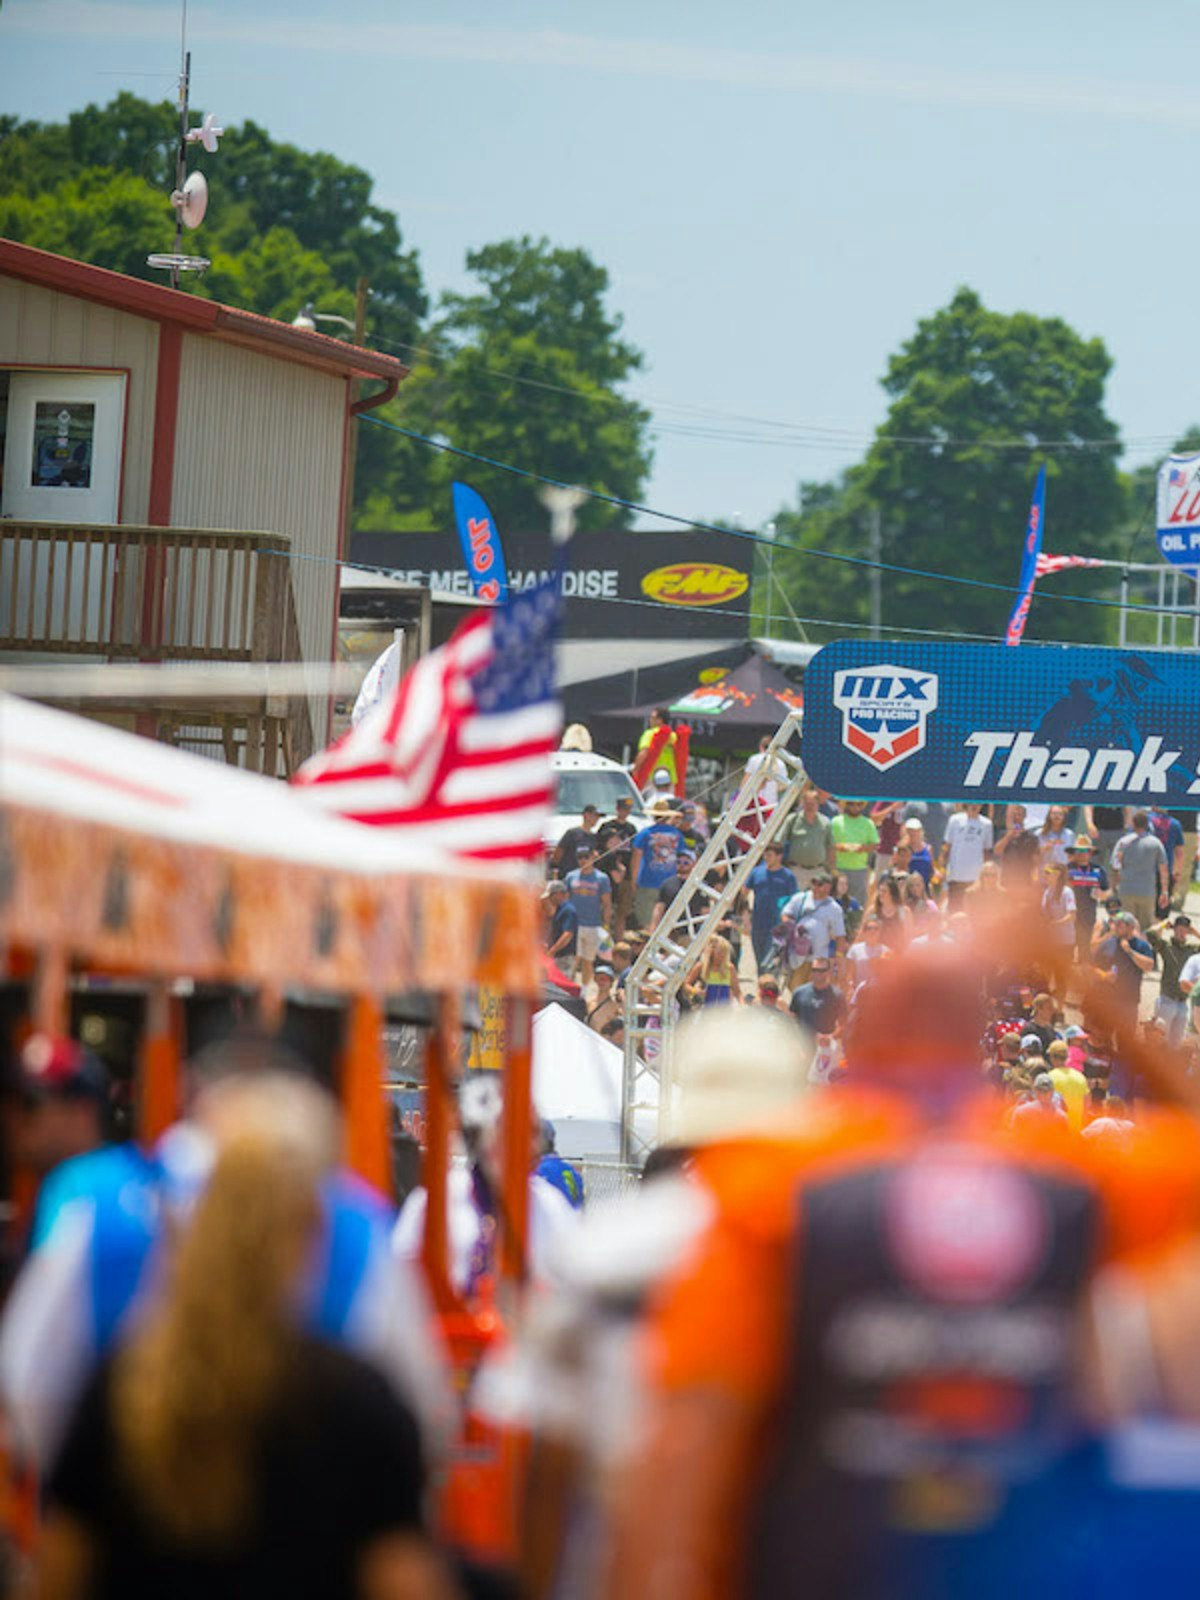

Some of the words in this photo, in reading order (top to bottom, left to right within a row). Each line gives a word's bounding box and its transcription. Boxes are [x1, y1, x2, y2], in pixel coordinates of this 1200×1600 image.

[1162, 534, 1187, 551] OIL
[642, 568, 749, 597] FMF
[851, 708, 875, 720] PRO
[876, 709, 918, 721] RACING
[963, 731, 1182, 794] Thank
